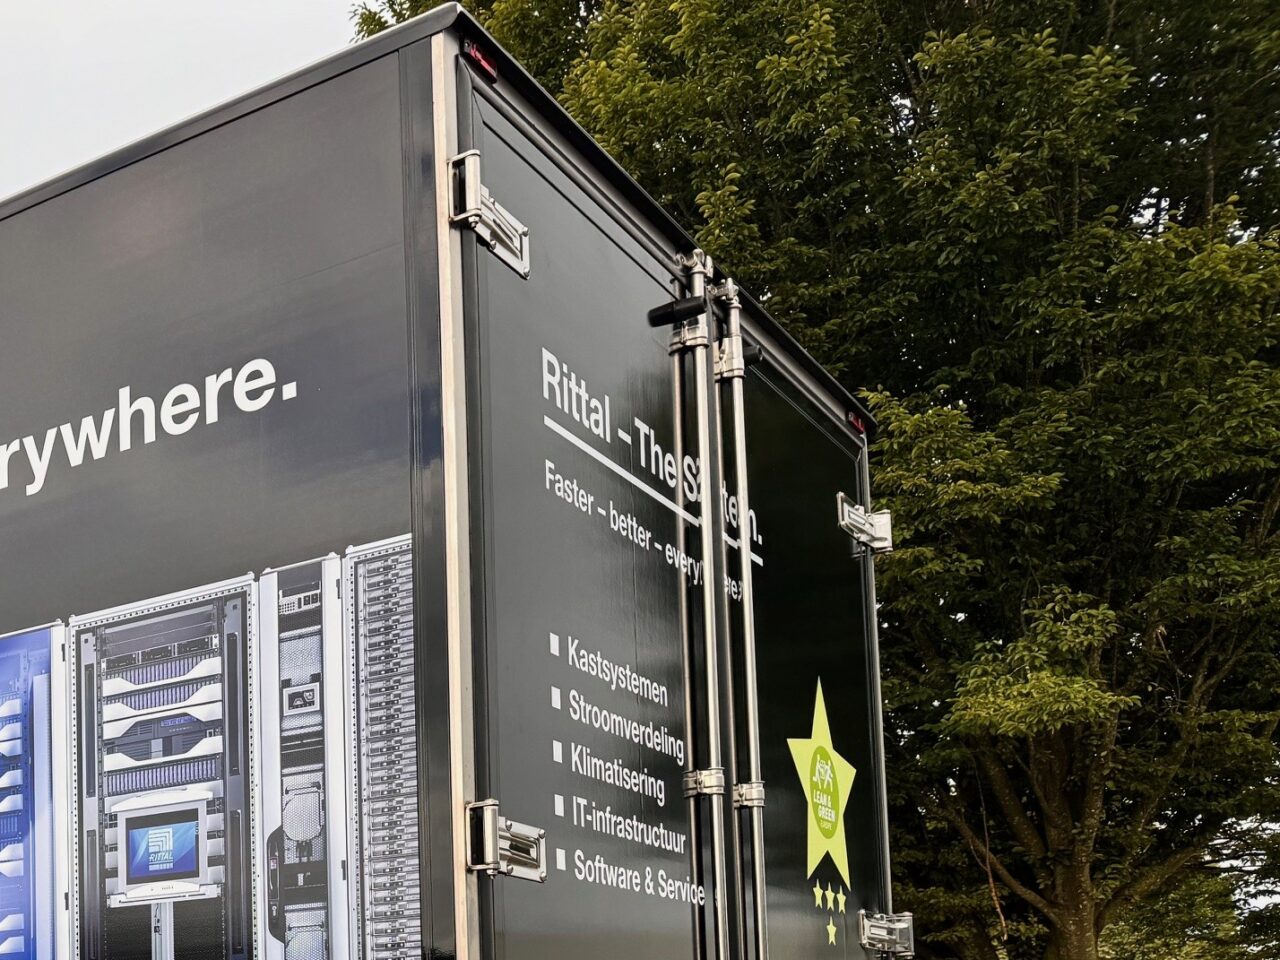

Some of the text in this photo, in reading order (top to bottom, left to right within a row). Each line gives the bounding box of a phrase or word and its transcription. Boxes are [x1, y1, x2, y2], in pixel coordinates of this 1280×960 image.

[542, 347, 611, 443] Rittal
[634, 417, 677, 488] The
[545, 459, 594, 515] Faster
[609, 500, 651, 550] better
[567, 636, 668, 707] Kastsystemen
[568, 689, 685, 766] Stroomverdeling
[570, 742, 665, 807] Klimatisering
[813, 789, 827, 806] LEAN
[572, 796, 686, 854] IT-infrastructuur
[818, 804, 836, 823] GREEN
[574, 849, 705, 906] Software & Service
